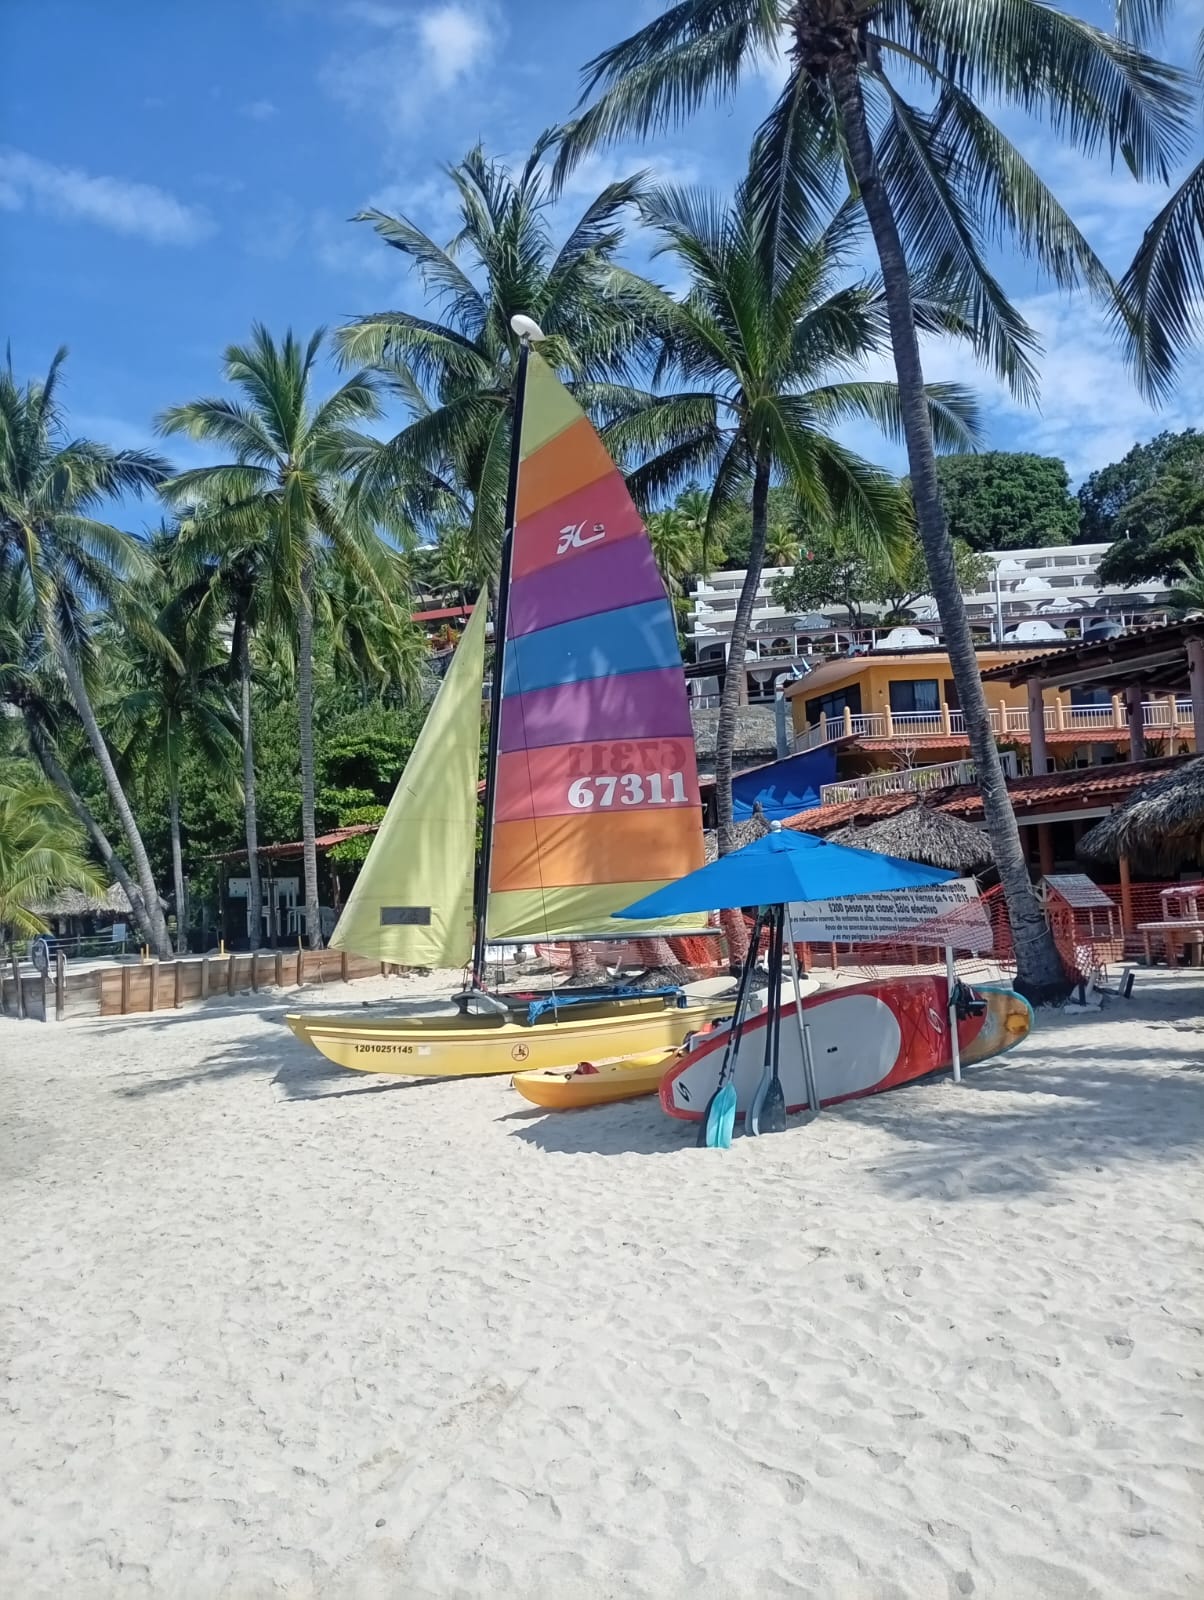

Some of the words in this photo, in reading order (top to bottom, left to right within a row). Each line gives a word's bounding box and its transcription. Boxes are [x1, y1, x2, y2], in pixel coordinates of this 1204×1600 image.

[567, 772, 689, 808] 67311
[828, 902, 844, 913] $200
[844, 904, 863, 917] pesos
[863, 904, 875, 917] por
[910, 903, 938, 914] efectivo
[354, 1044, 413, 1054] 12010251145
